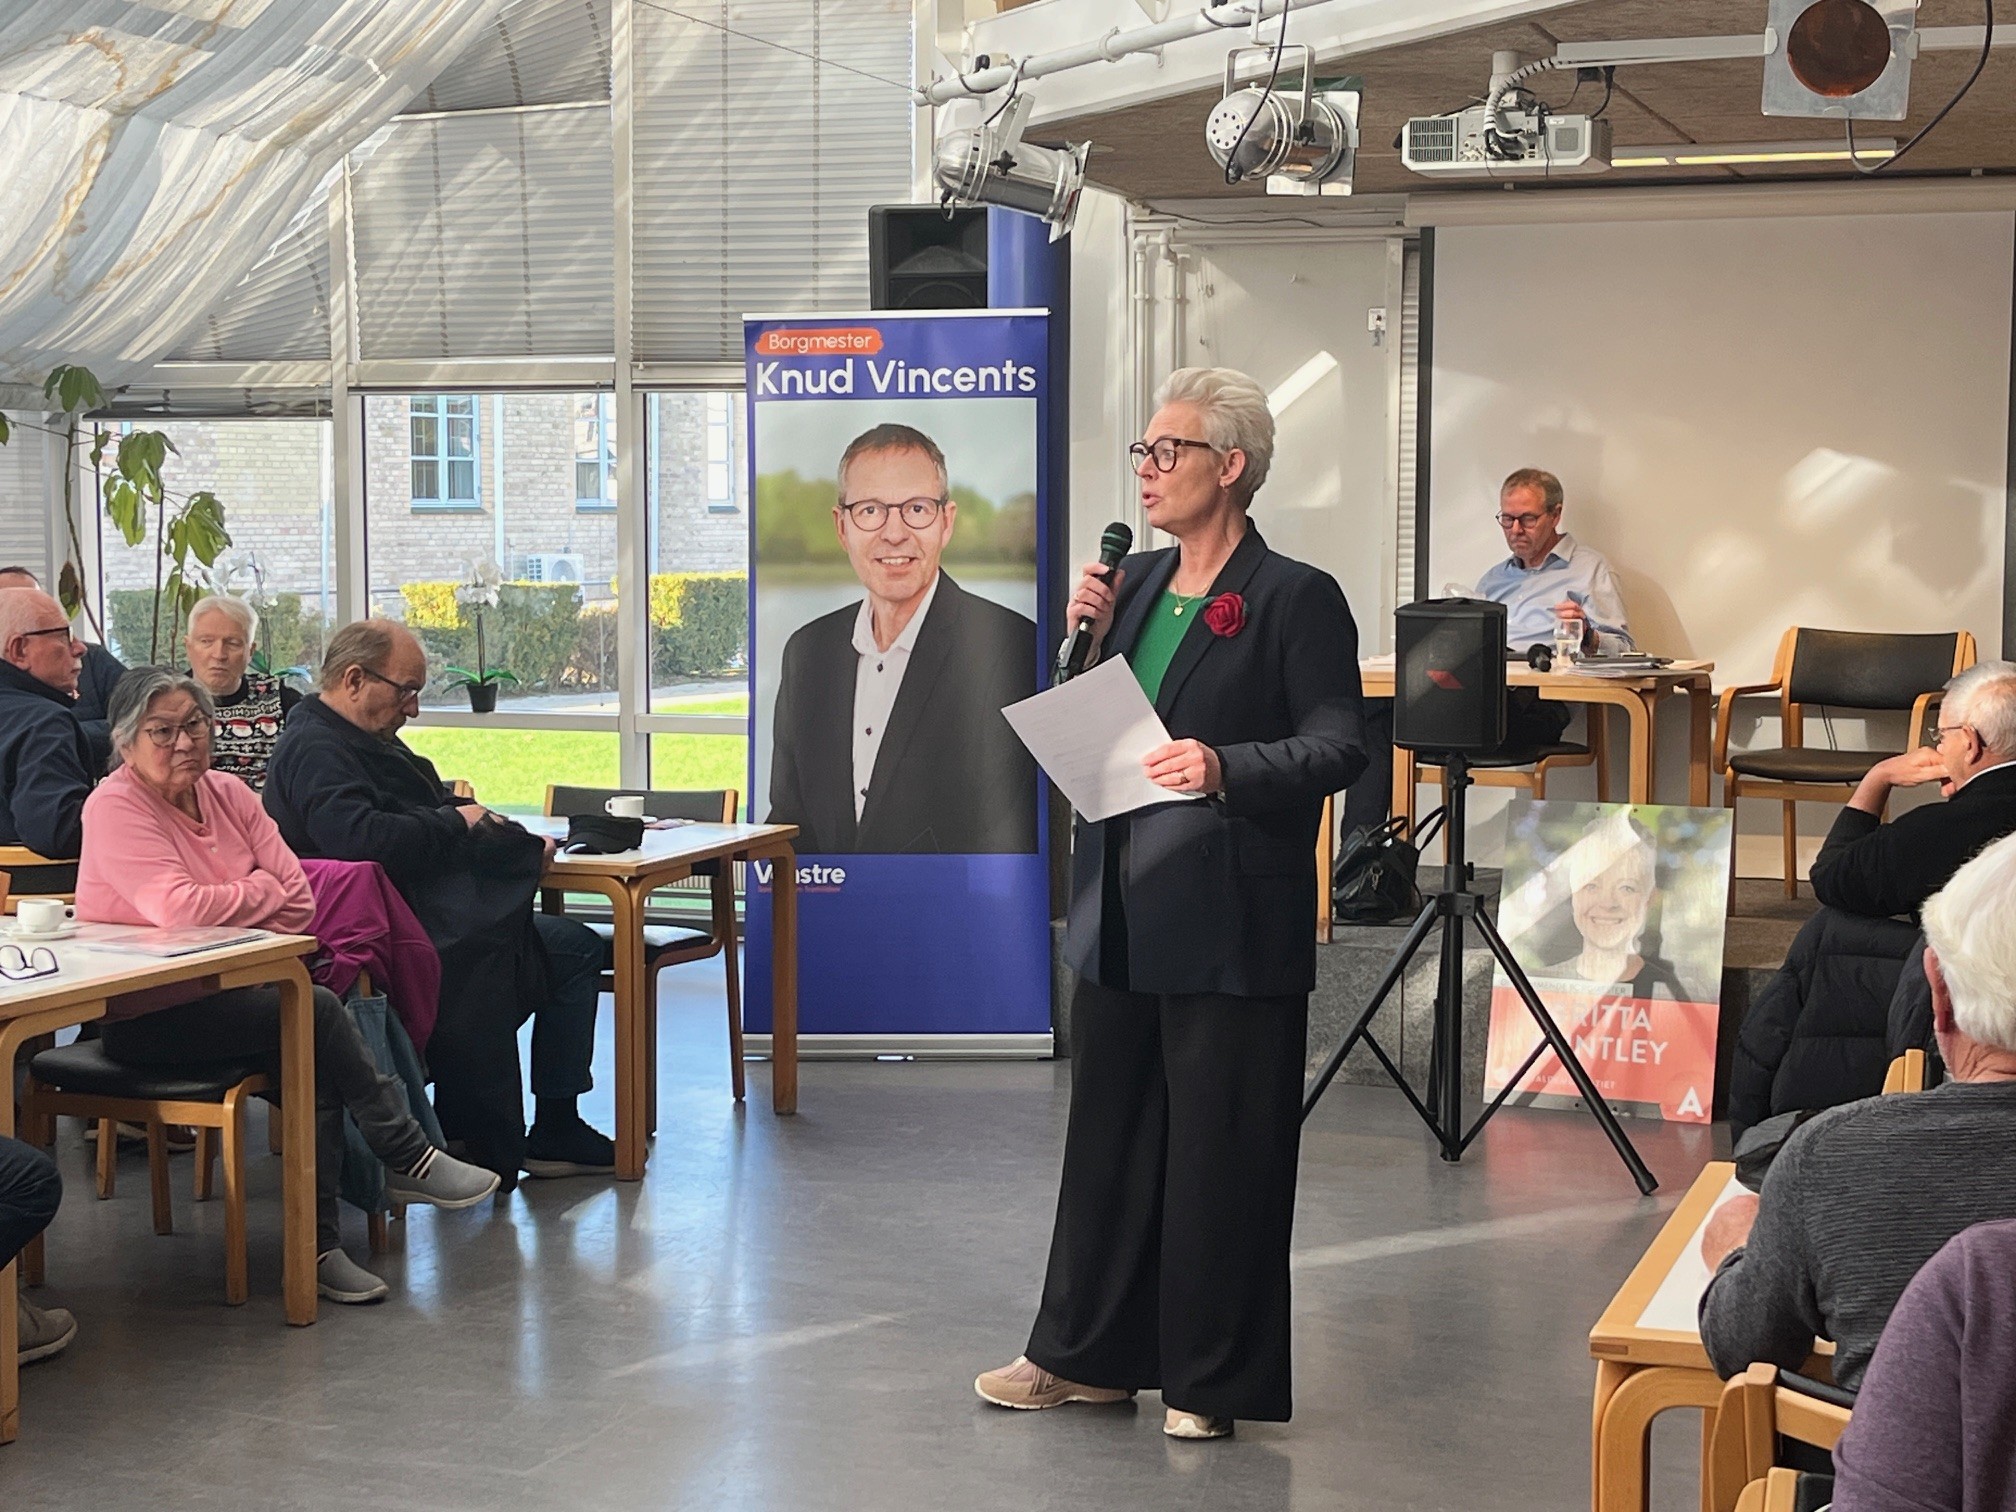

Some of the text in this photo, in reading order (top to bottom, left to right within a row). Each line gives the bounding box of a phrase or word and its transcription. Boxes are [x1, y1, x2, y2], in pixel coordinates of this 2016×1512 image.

[768, 332, 872, 354] Borgmester
[756, 358, 1037, 396] Knud Vincents
[753, 859, 846, 884] Vstre
[1562, 1002, 1652, 1032] ITTA
[1574, 1034, 1668, 1065] NTLEY
[1676, 1086, 1704, 1117] A
